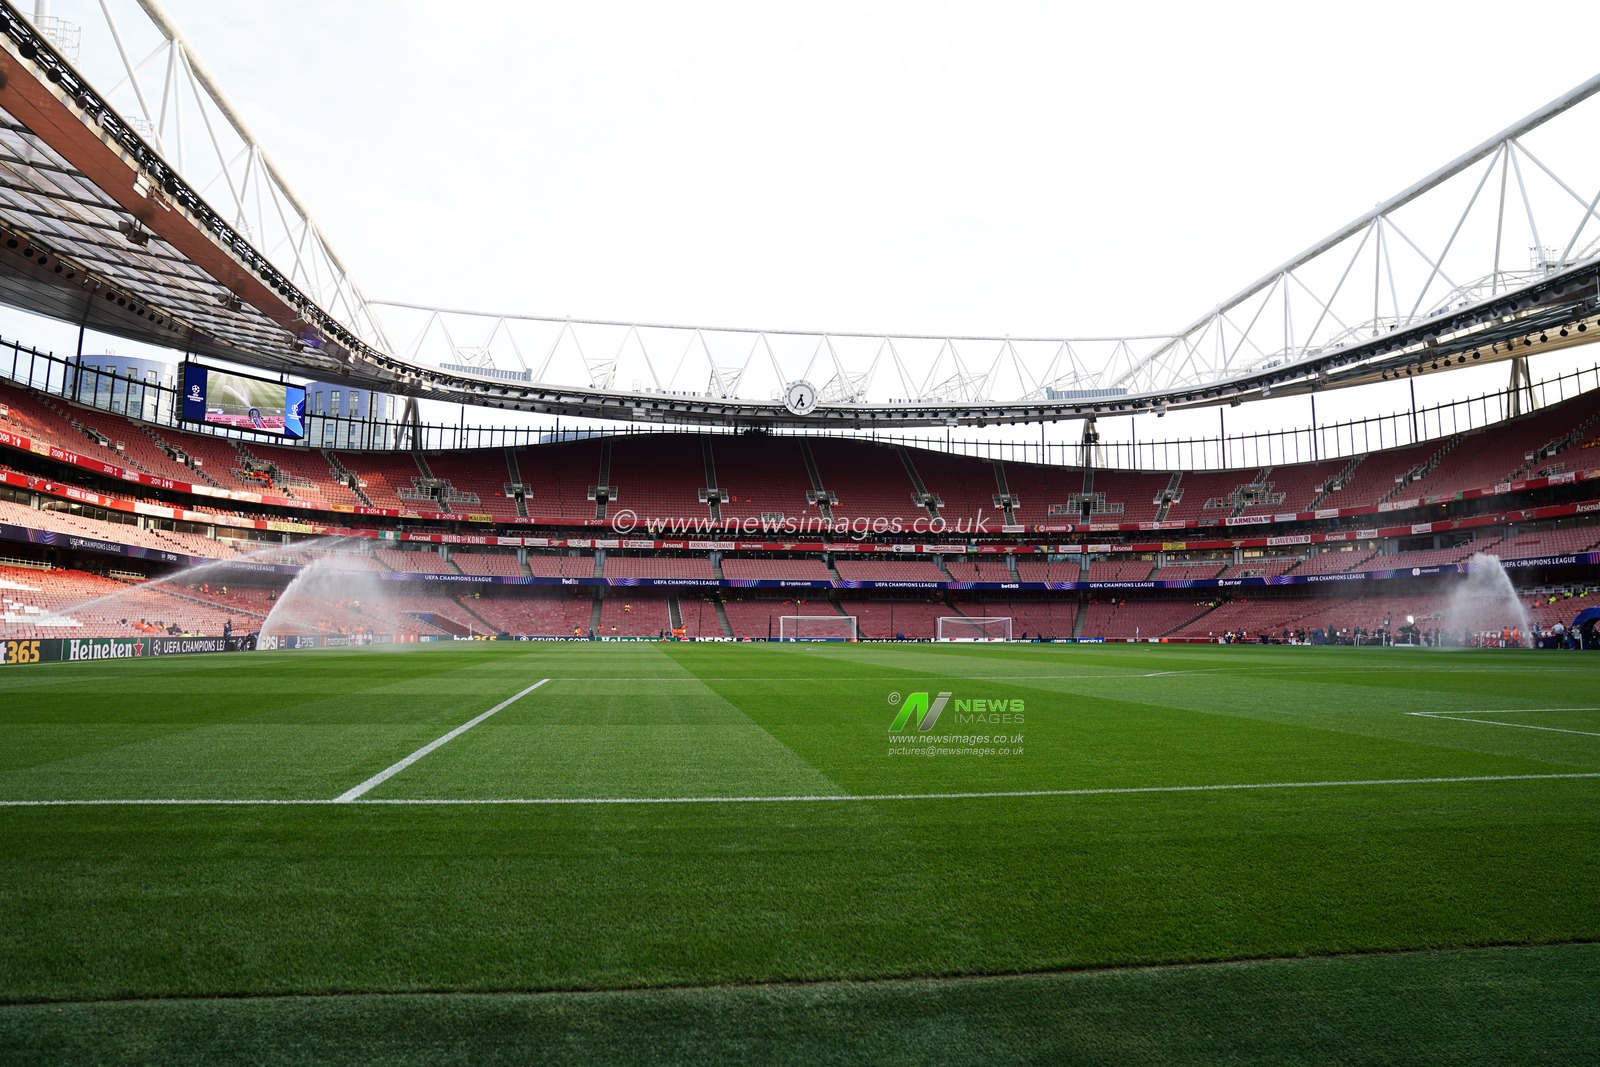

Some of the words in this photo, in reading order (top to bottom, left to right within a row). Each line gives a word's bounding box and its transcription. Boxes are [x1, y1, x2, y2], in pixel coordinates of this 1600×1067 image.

[51, 448, 64, 459] 2009
[366, 507, 380, 515] 2014
[1576, 502, 1600, 513] Arsenal
[1234, 516, 1263, 525] ARMENIA
[273, 522, 311, 533] AUSTRALIA
[408, 533, 431, 542] Arsenal
[1324, 533, 1346, 541] Arsenal
[82, 540, 106, 551] CHAMPIONS
[105, 543, 121, 553] LEAGUE
[662, 541, 683, 549] Arsenal
[1516, 558, 1552, 568] CHAMPIONS
[1552, 556, 1576, 565] LEAGUE
[163, 640, 181, 653] UEFA
[181, 639, 216, 652] CHAMPIONS
[301, 637, 314, 647] PS5
[69, 639, 132, 660] Heineken
